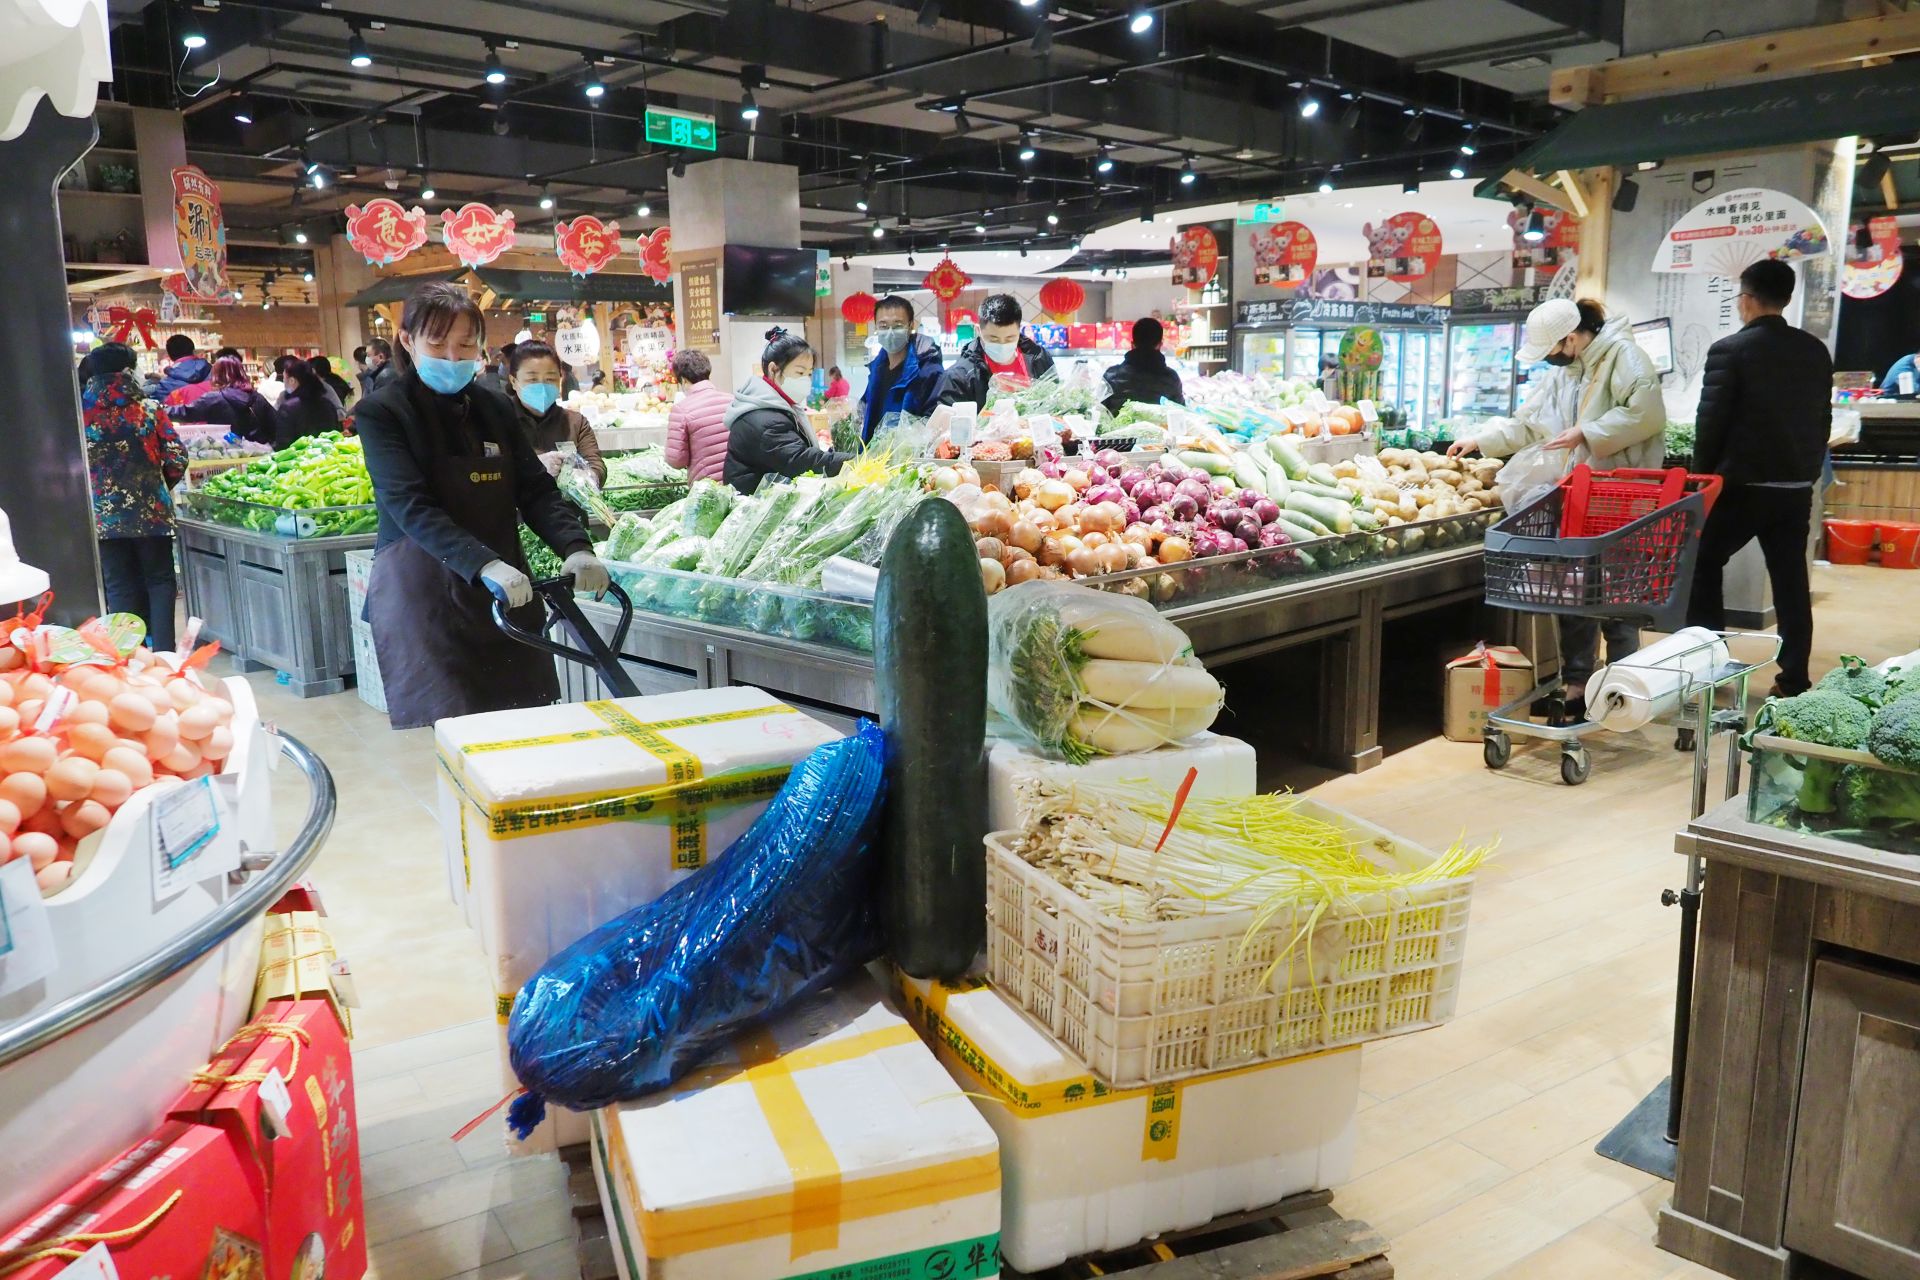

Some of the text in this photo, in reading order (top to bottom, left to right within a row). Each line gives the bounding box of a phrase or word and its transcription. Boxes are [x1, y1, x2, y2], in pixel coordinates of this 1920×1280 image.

[1705, 200, 1762, 216] 水嫩看得见
[1730, 209, 1787, 225] 甜到心里面
[374, 206, 406, 249] 意
[461, 211, 504, 246] 如
[579, 225, 605, 257] 安
[1323, 303, 1355, 318] 冷冻食品
[675, 819, 701, 870] 品蔬菜
